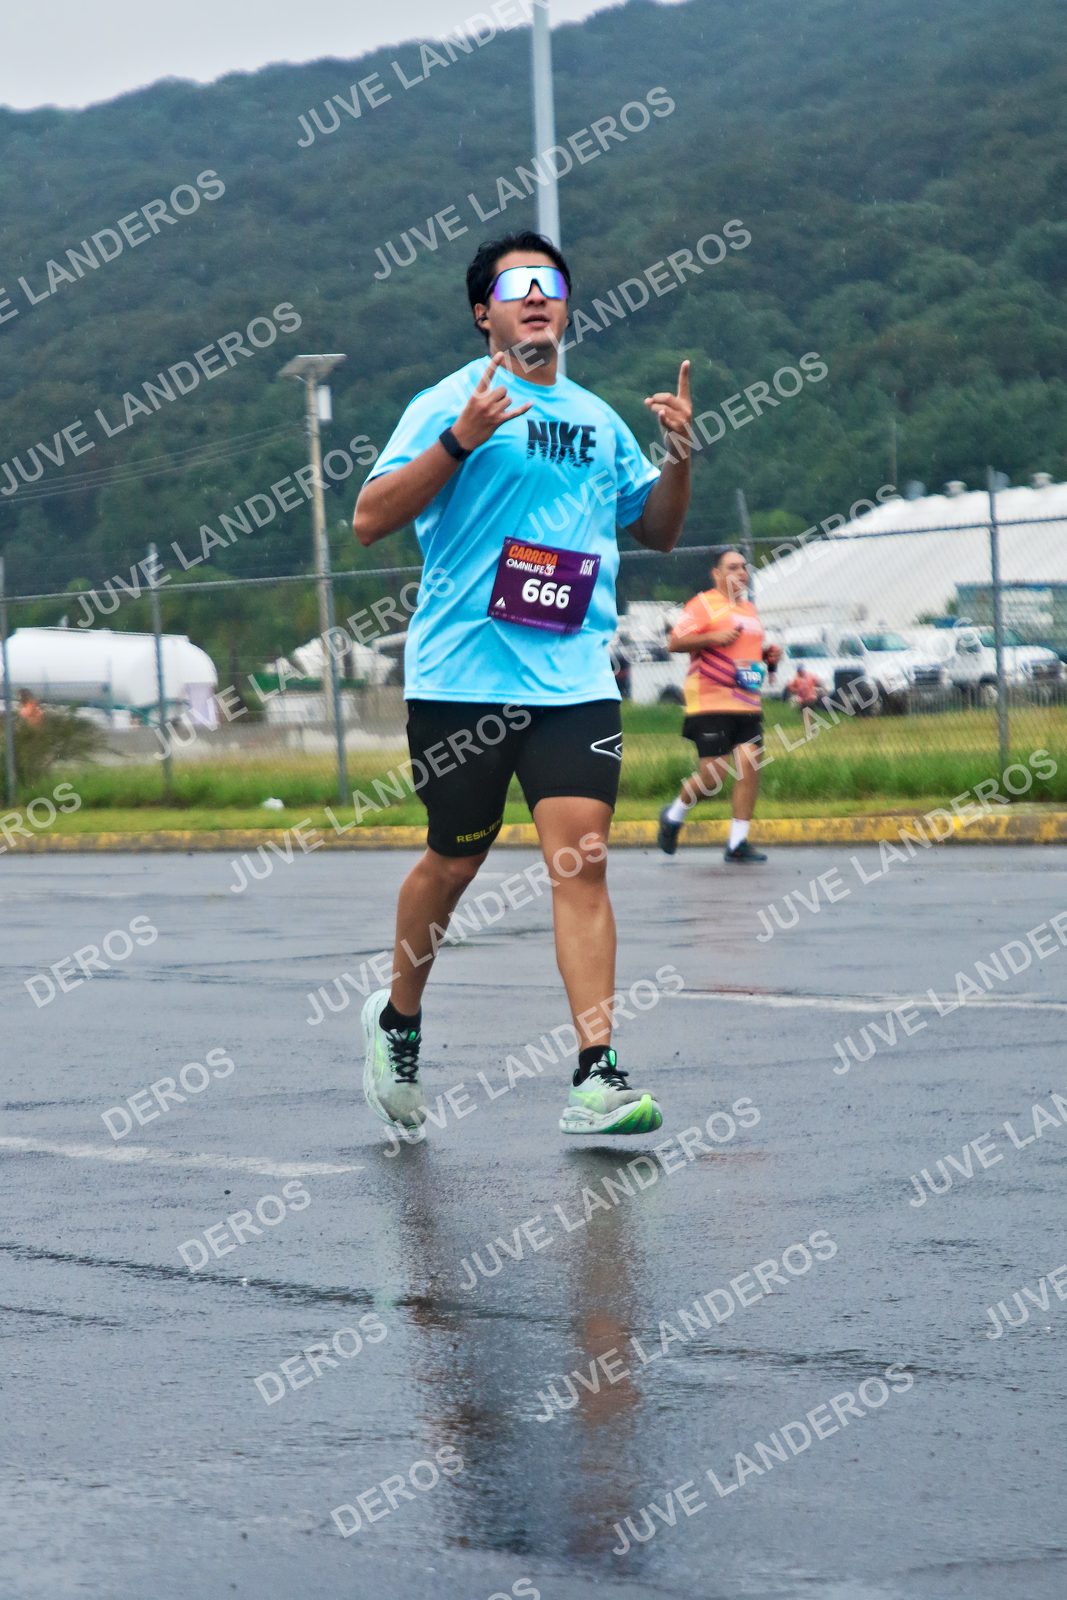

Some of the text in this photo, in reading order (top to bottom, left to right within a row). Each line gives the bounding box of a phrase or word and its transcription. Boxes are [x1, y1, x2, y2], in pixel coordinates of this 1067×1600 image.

[527, 419, 597, 455] NIKE
[506, 558, 544, 575] OMNILIFE
[508, 544, 558, 566] CARRERA
[522, 578, 571, 609] 666
